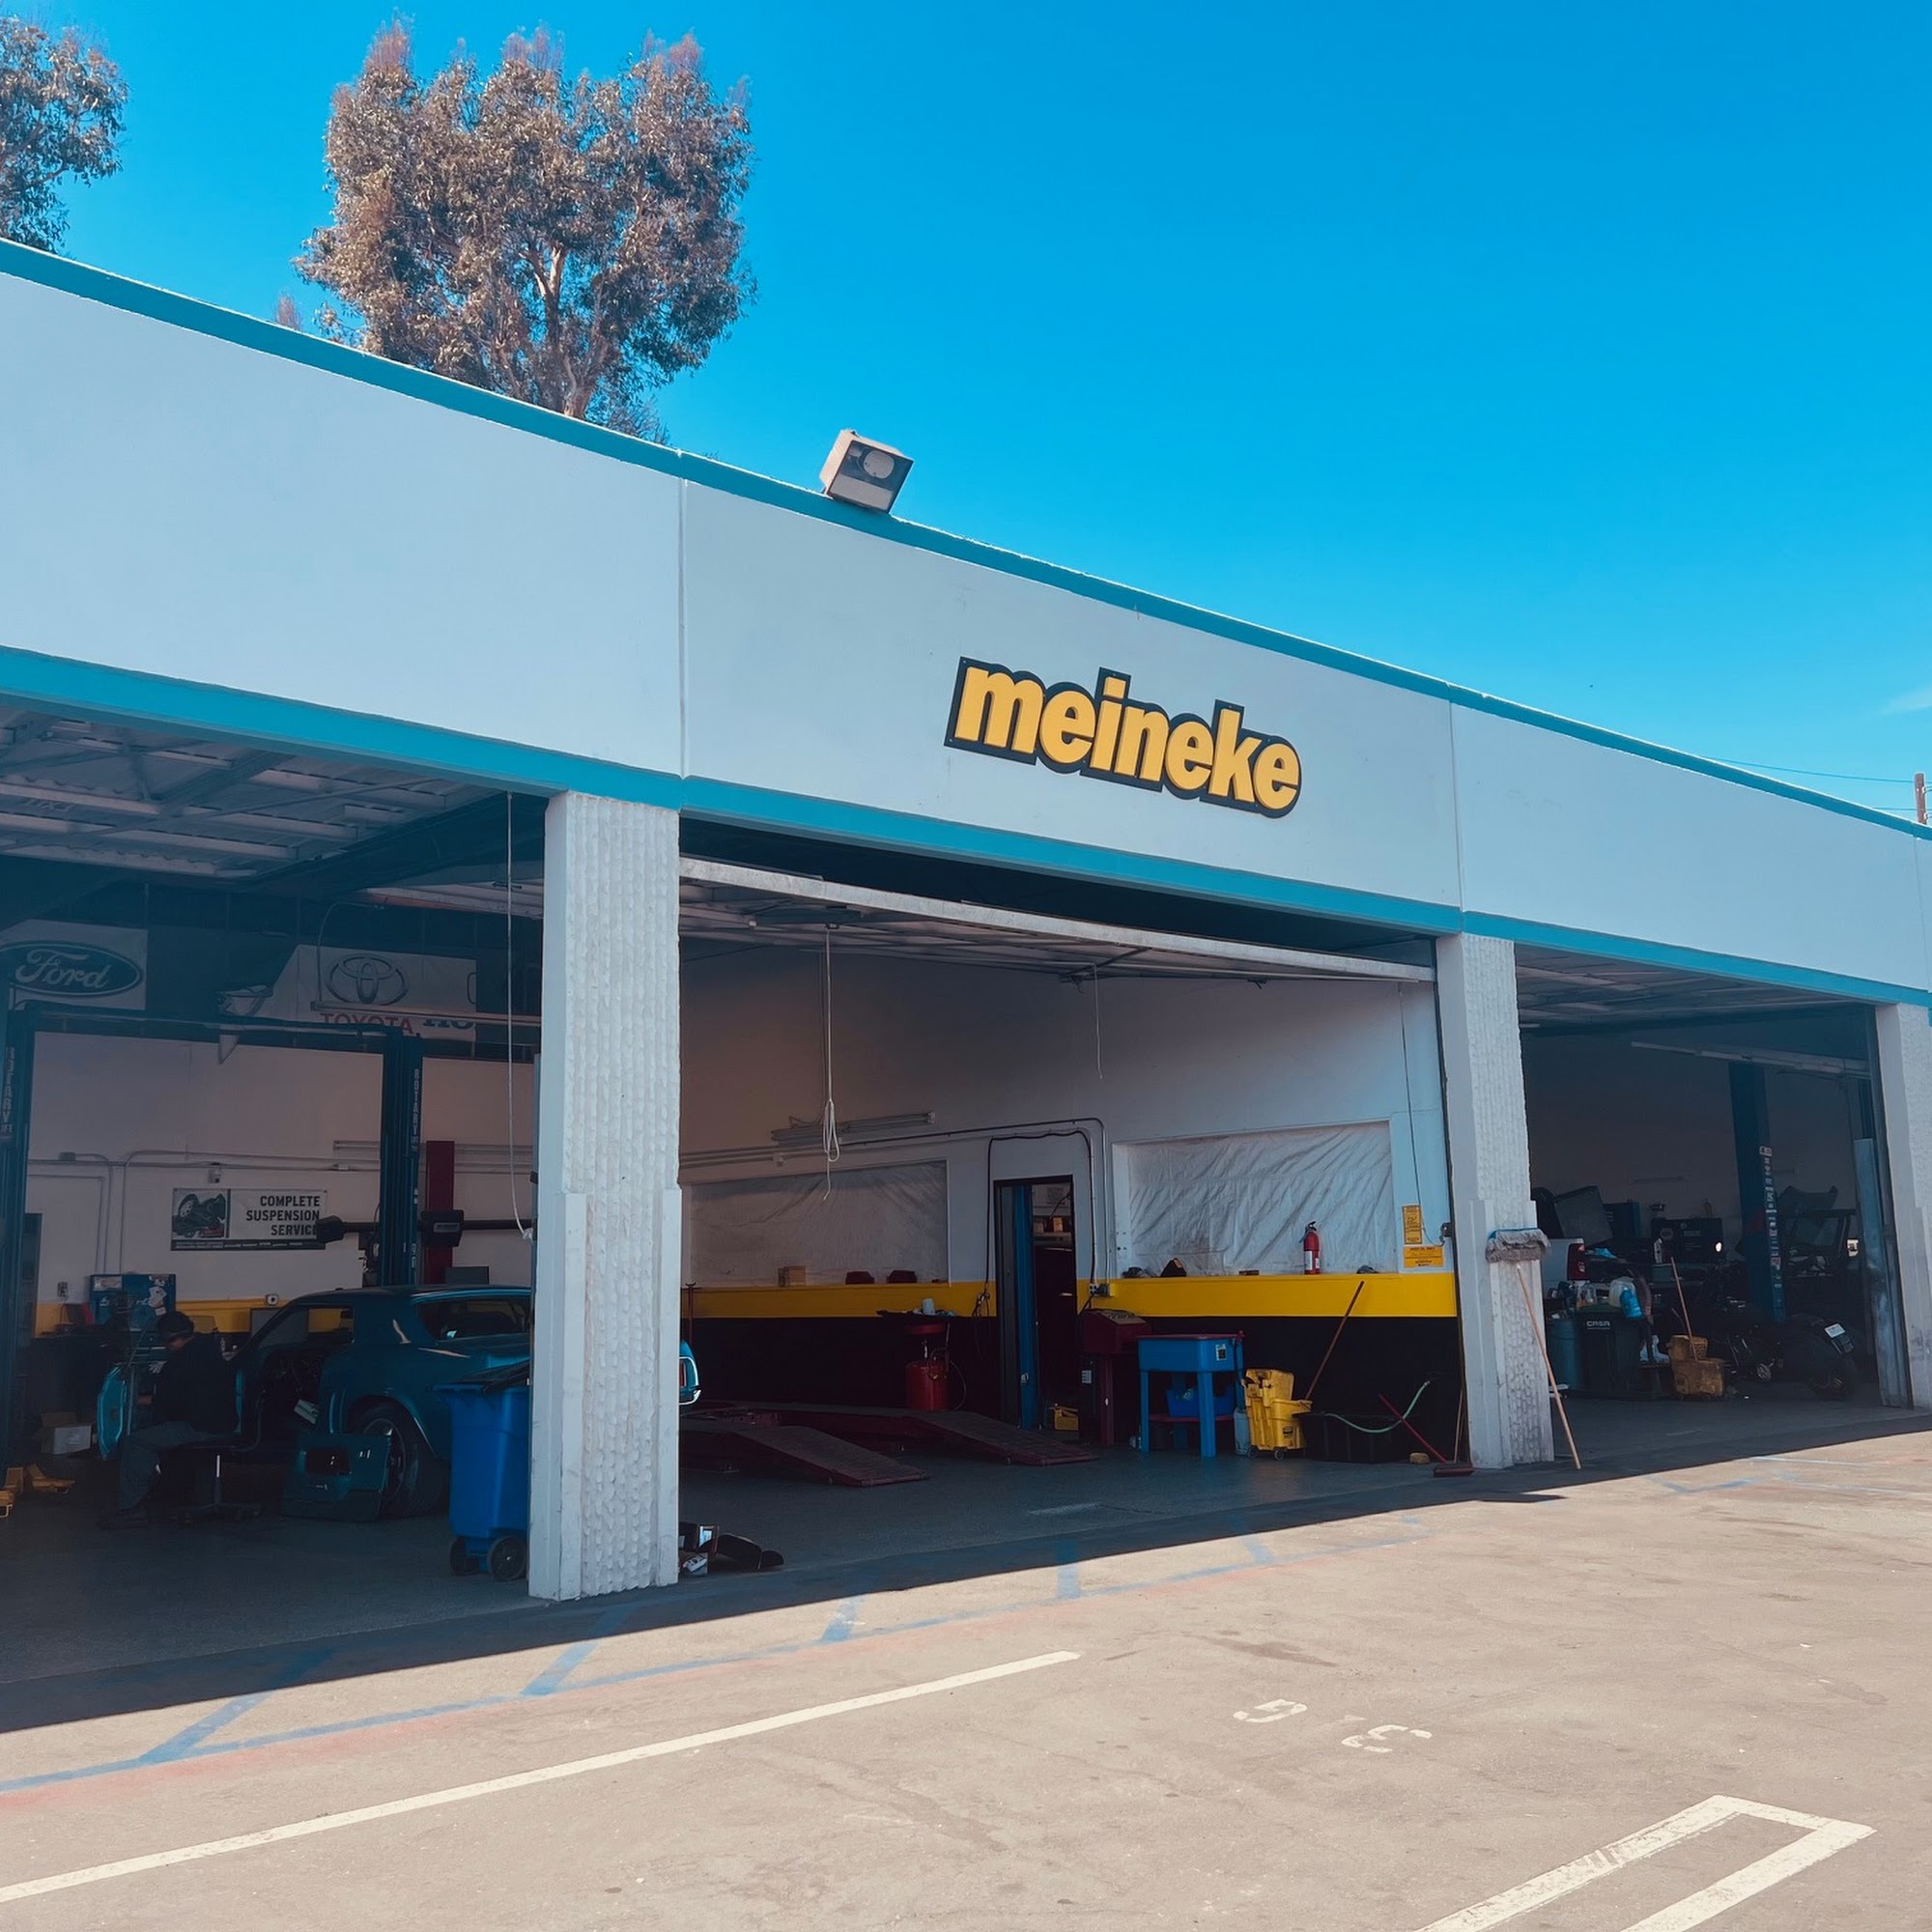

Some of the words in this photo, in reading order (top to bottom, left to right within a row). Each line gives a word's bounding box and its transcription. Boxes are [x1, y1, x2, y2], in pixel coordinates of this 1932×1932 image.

[952, 664, 1301, 811] meineke
[15, 949, 113, 989] Ford
[260, 1195, 321, 1208] COMPLETE
[245, 1209, 320, 1222] SUSPENSION
